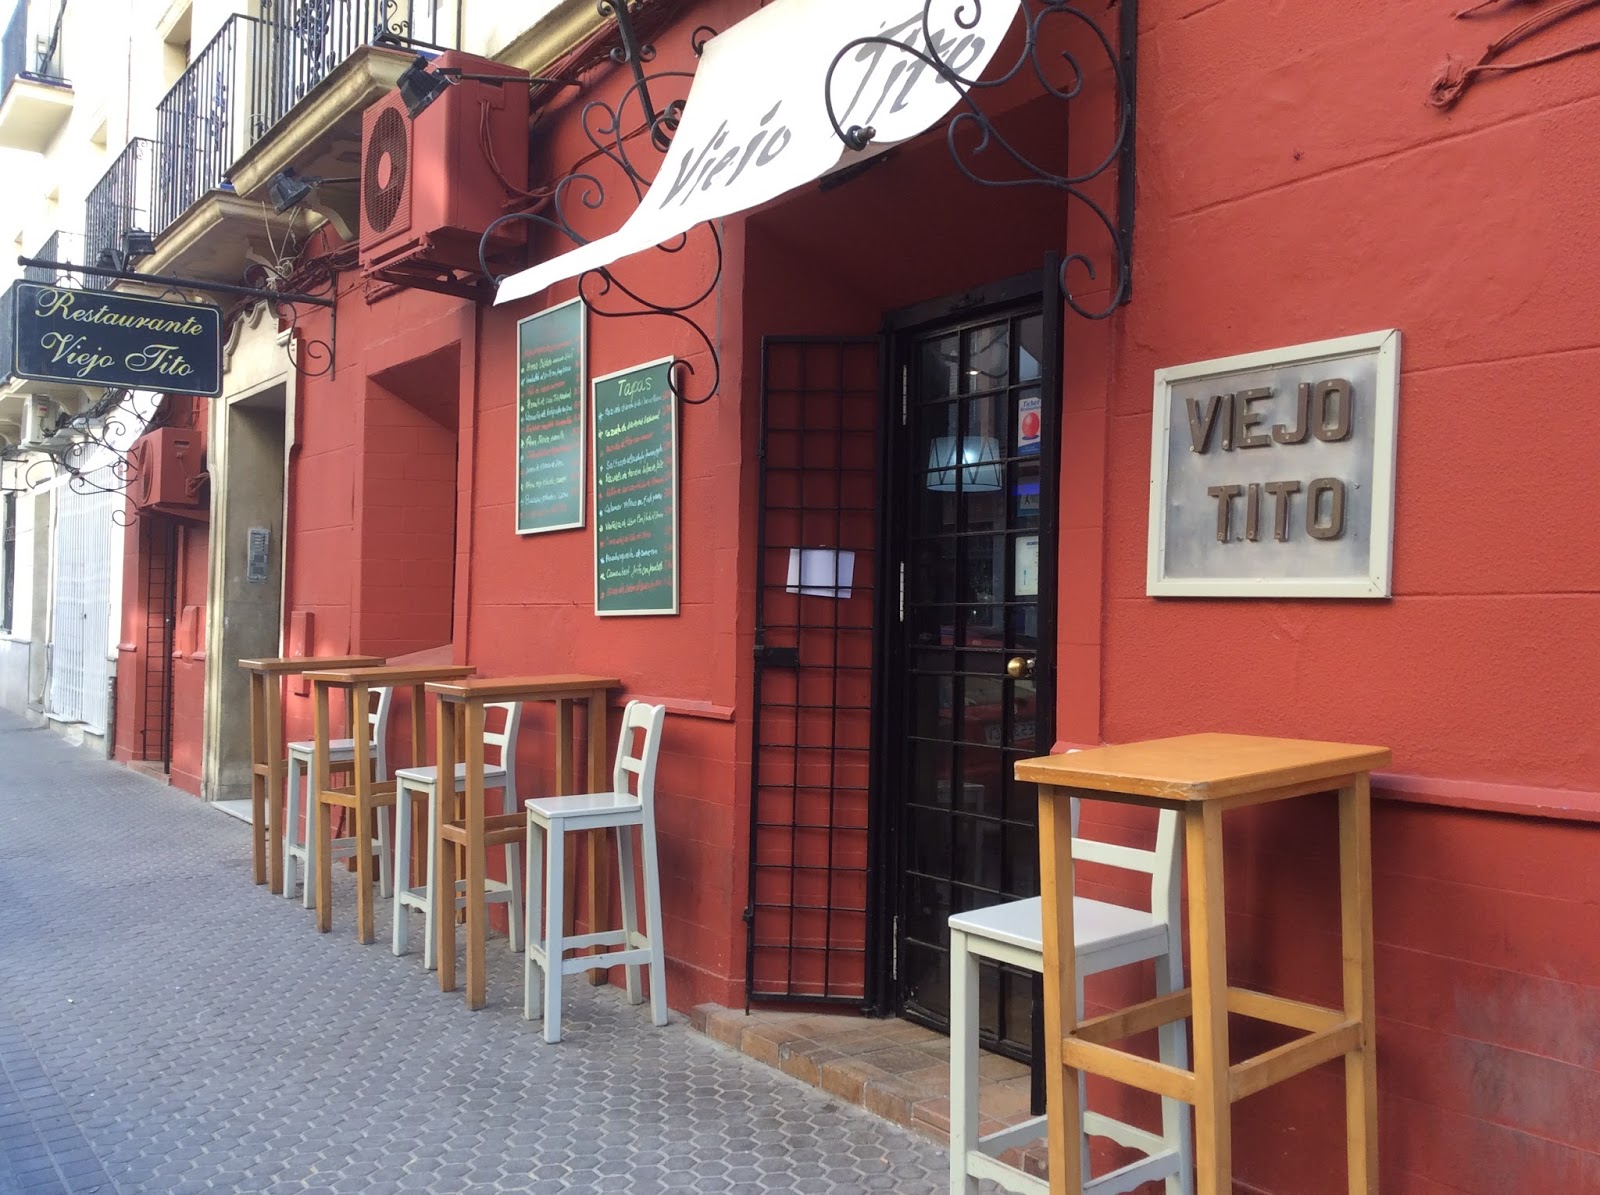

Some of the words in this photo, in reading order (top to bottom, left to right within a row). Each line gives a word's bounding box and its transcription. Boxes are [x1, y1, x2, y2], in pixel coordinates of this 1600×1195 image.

[659, 100, 791, 210] Viejo
[831, 11, 986, 138] Tito
[35, 287, 203, 336] Restaurante
[41, 331, 115, 378] Viejo
[125, 344, 194, 377] Tito
[618, 377, 652, 403] Tapas
[1186, 378, 1352, 454] VIEJO
[1208, 478, 1345, 542] TITO
